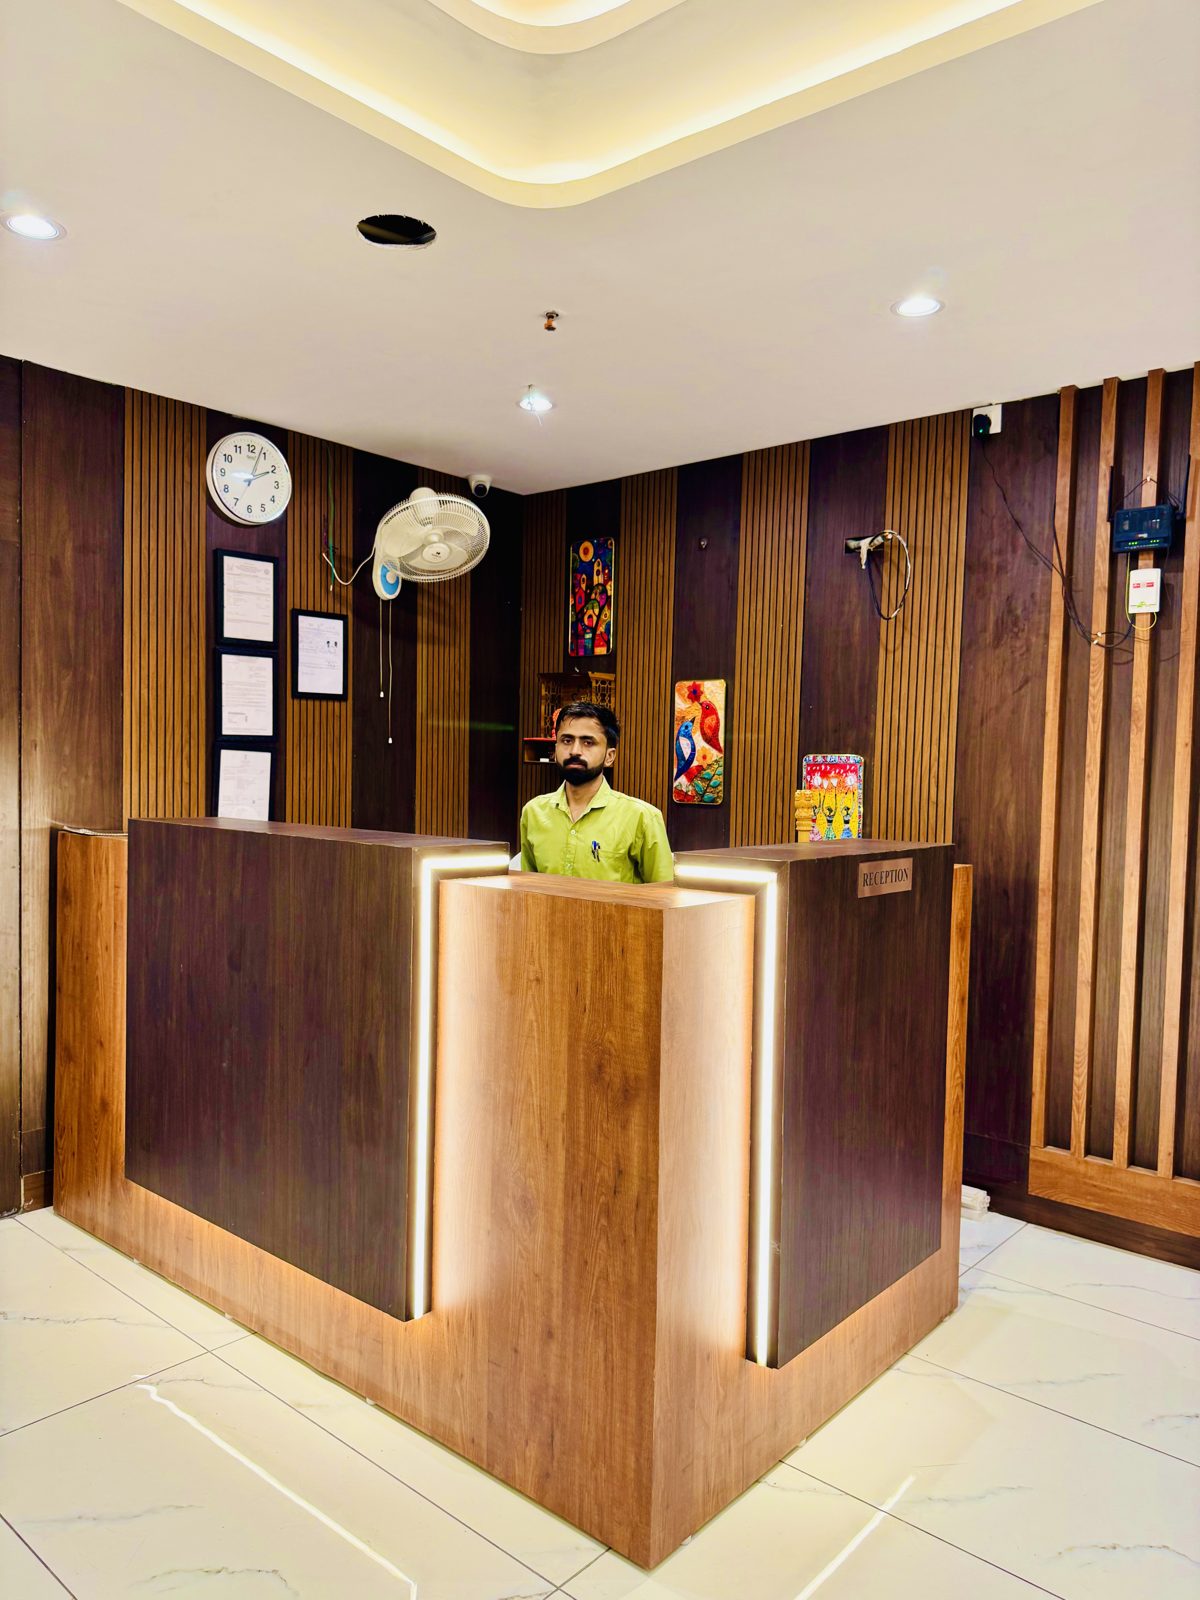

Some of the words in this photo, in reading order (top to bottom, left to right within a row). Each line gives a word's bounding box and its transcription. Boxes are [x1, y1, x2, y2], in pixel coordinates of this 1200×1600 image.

[234, 445, 242, 454] 11
[247, 444, 256, 454] 12
[223, 454, 232, 464] 10
[262, 452, 266, 460] 1
[220, 468, 226, 476] 9
[271, 465, 276, 474] 2
[224, 484, 229, 493] 8
[274, 481, 280, 490] 3
[234, 498, 239, 506] 7
[247, 505, 252, 514] 6
[260, 504, 266, 512] 5
[863, 868, 908, 887] RECEPTION
